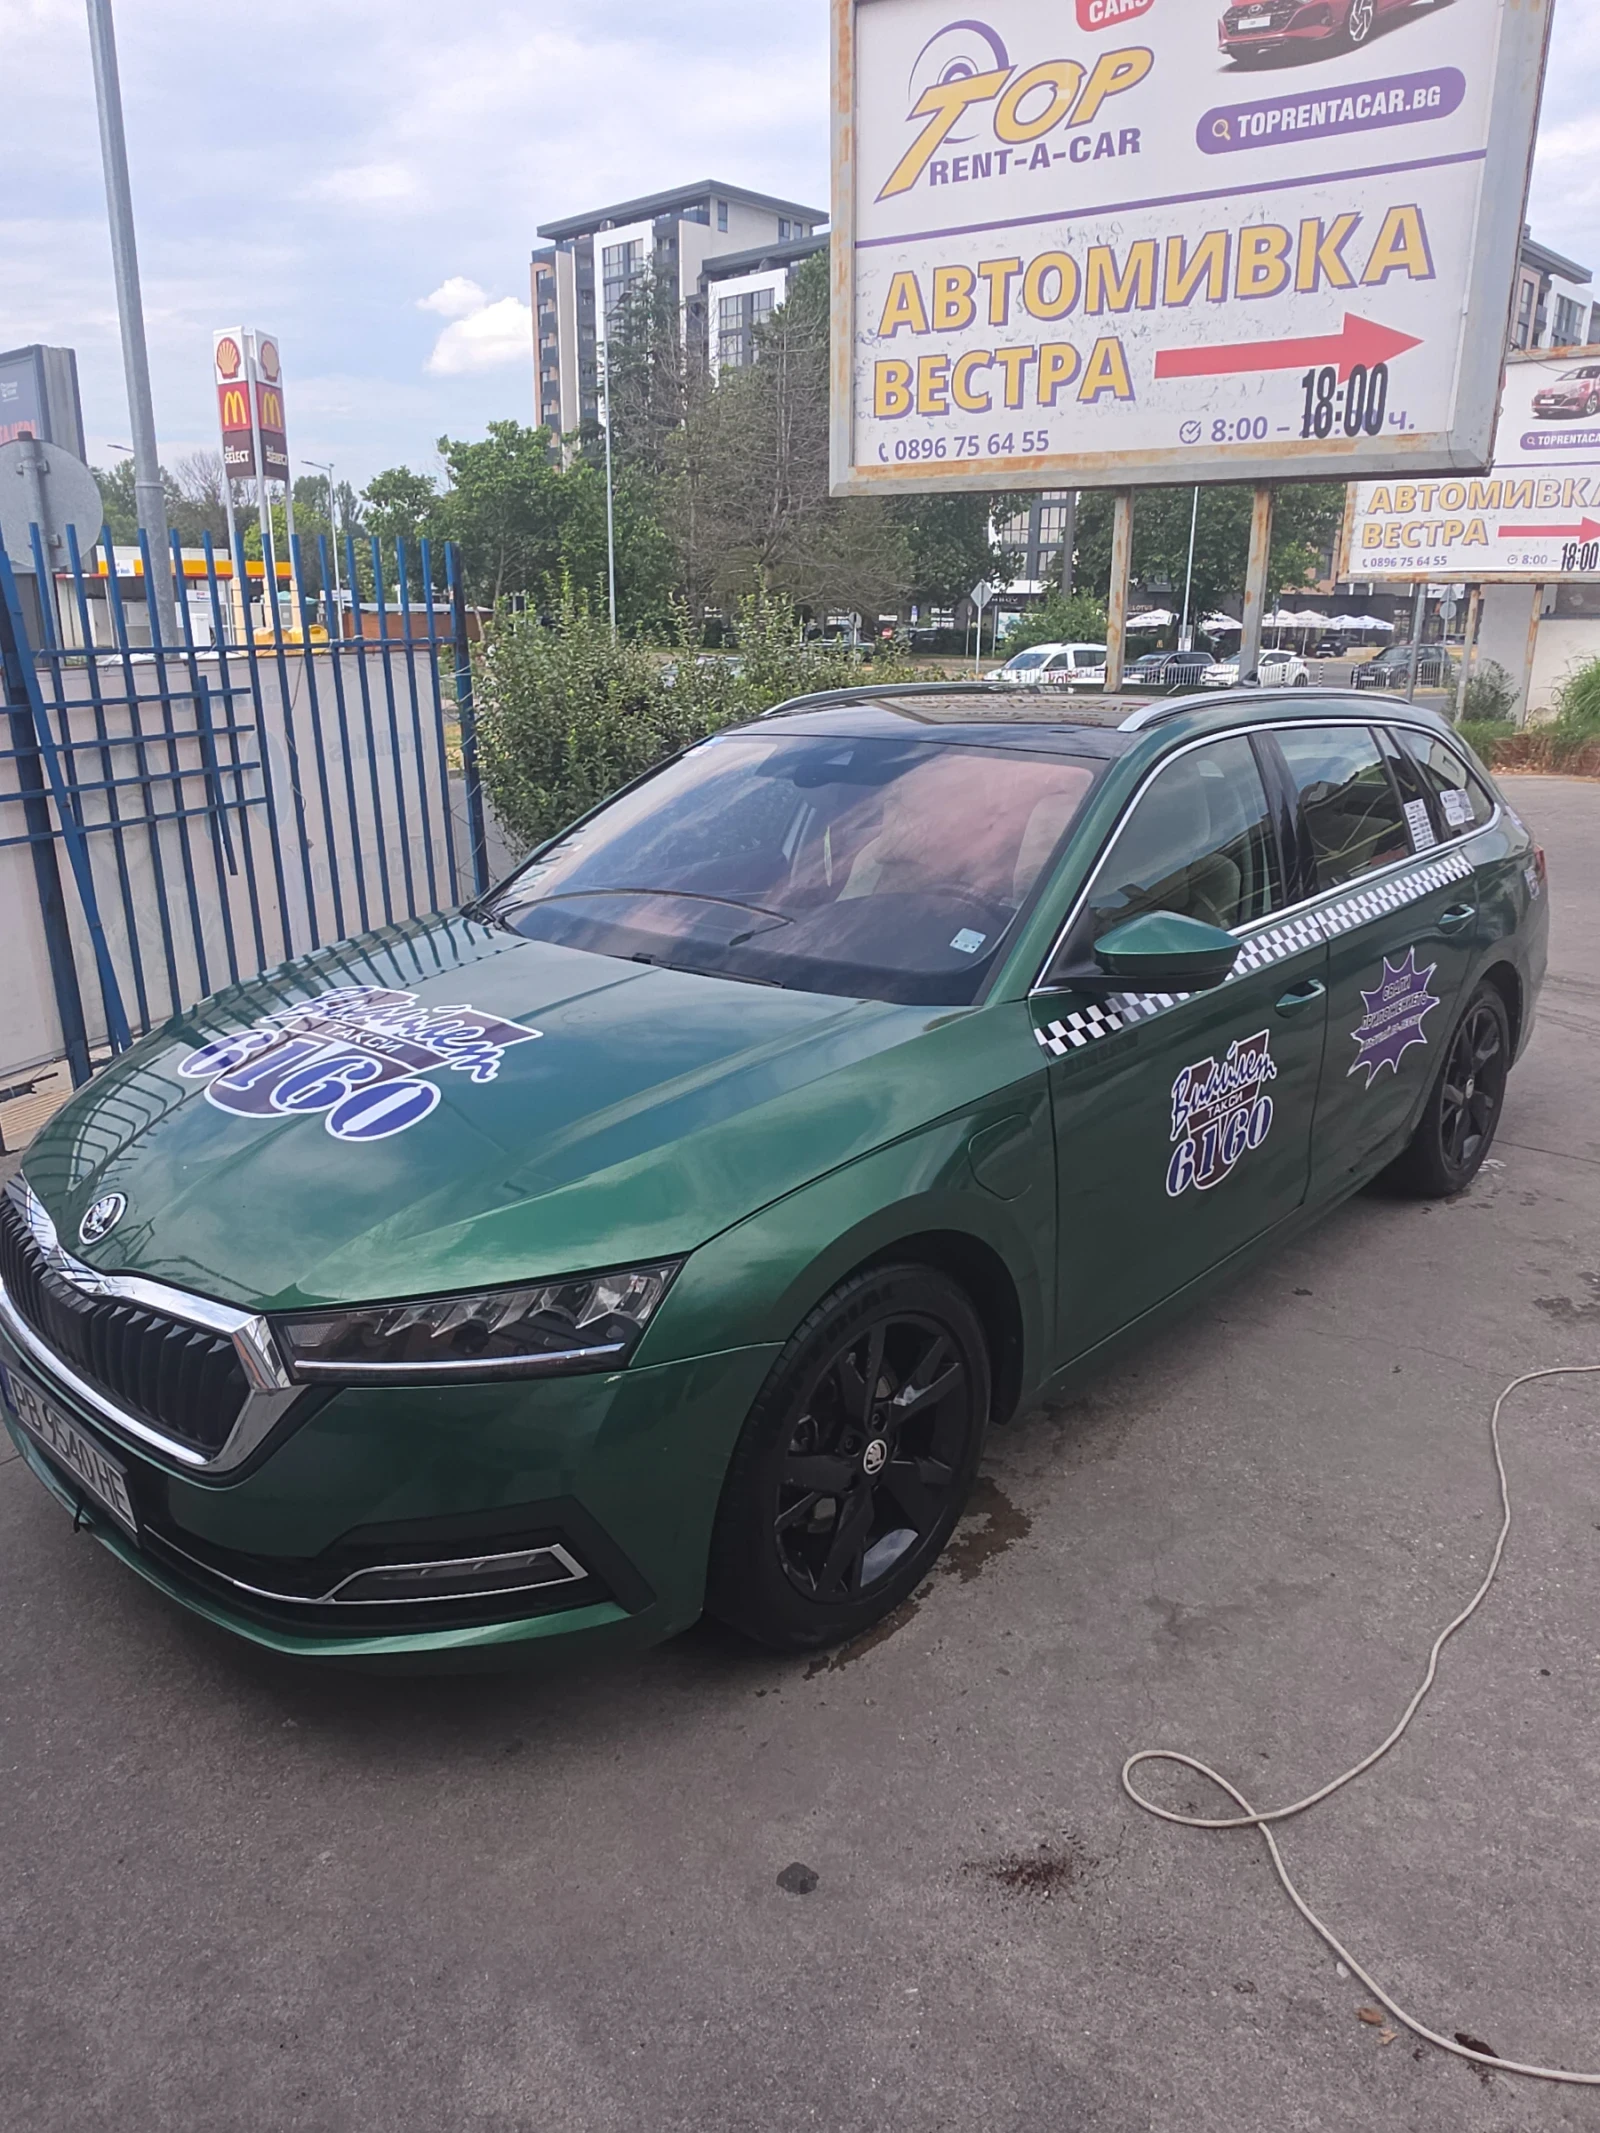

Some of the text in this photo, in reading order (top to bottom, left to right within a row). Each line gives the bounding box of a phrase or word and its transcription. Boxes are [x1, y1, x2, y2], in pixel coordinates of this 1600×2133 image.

[874, 46, 1154, 204] TOP
[1237, 85, 1441, 139] TOPRENTACAR.BG
[929, 127, 1141, 187] RENT-A-CAR
[877, 204, 1436, 338] АВТОМИВКА
[873, 337, 1136, 421] ВЕСТРА
[1211, 416, 1268, 442] 8:00
[1301, 363, 1388, 439] 18:00
[224, 450, 249, 463] SELECT
[895, 430, 1049, 460] 0896 75 64 55
[1361, 518, 1489, 549] ВЕСТРА
[1370, 555, 1447, 568] 0896 75 64 55
[1521, 554, 1548, 565] 8:00
[1561, 542, 1599, 571] 18:00
[324, 1024, 404, 1053] ТАКСИ
[178, 1028, 441, 1142] 6160
[1207, 1090, 1243, 1118] ТАКСИ
[1166, 1096, 1273, 1197] 6160
[92, 1452, 131, 1522] HE
